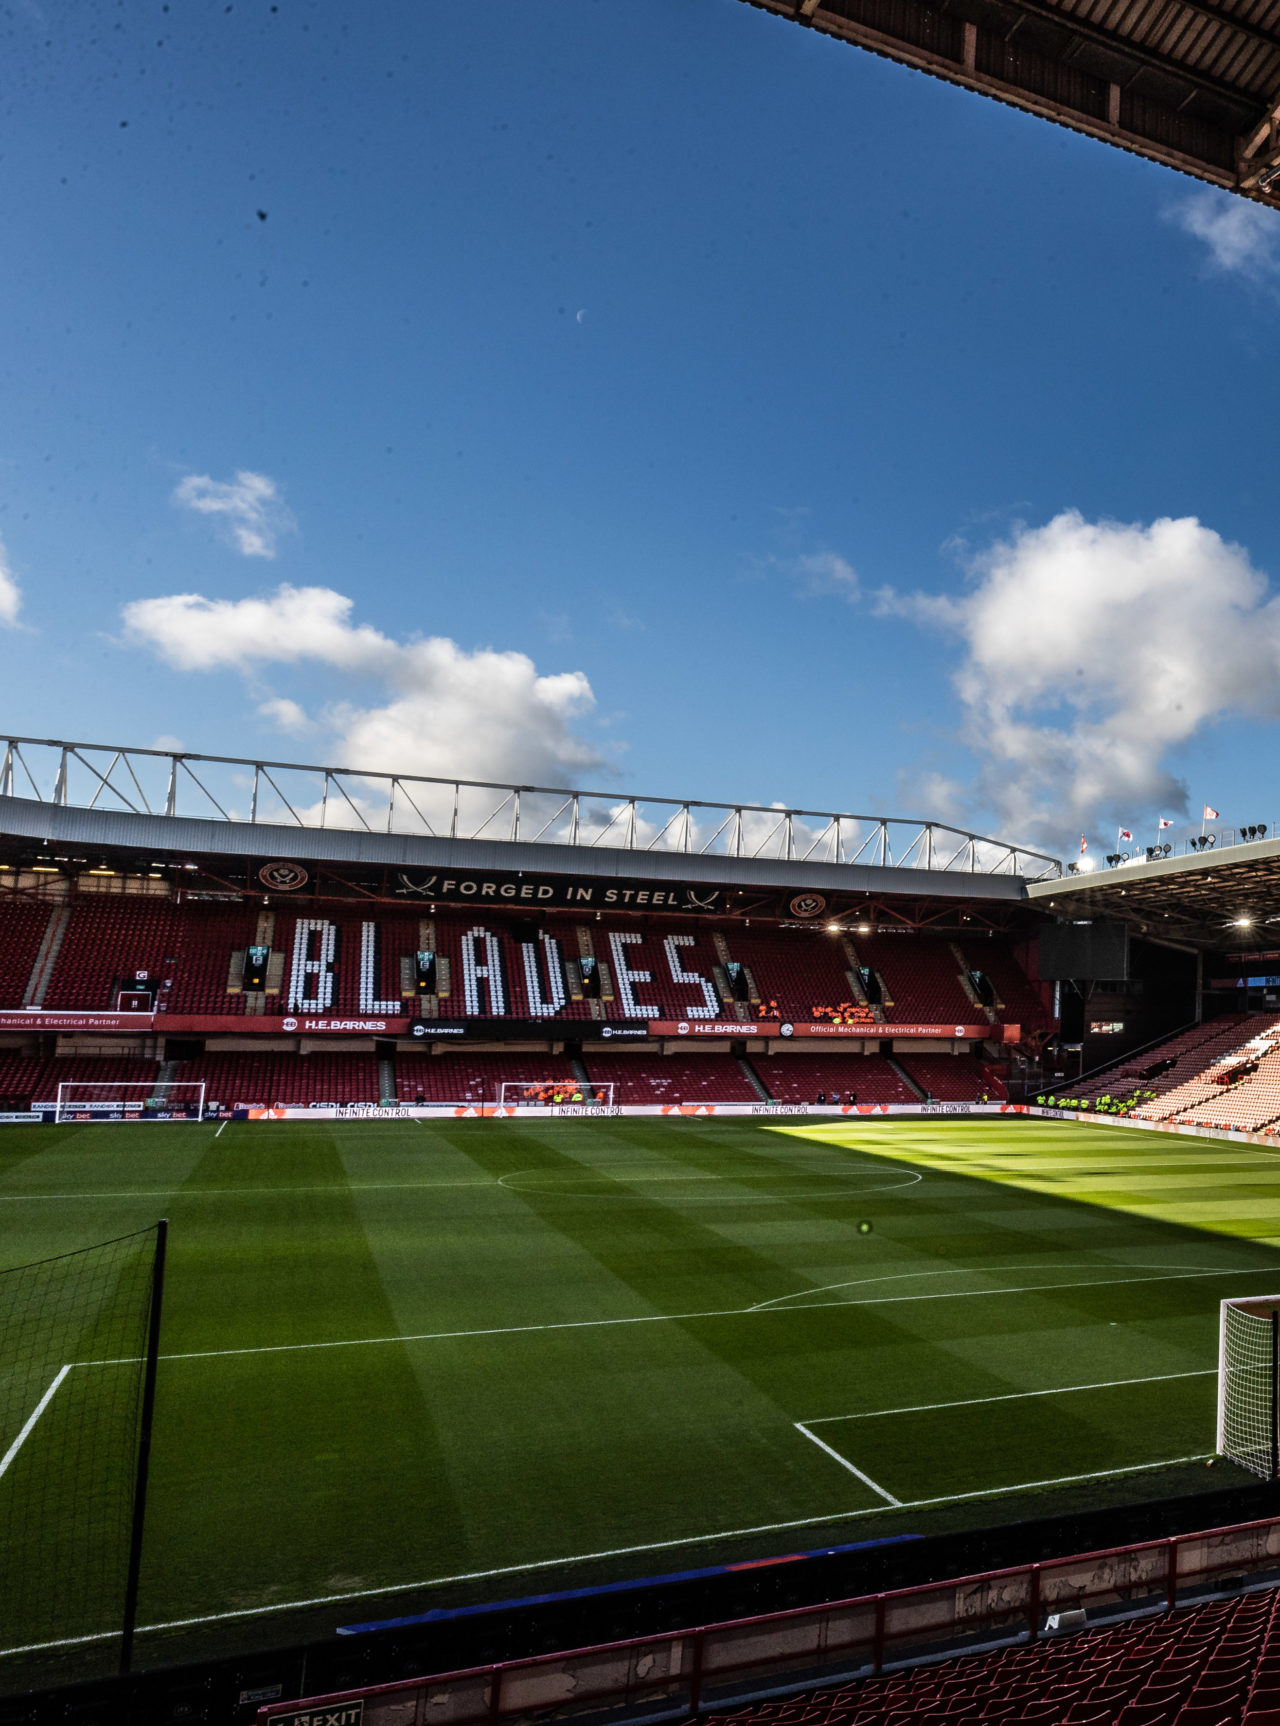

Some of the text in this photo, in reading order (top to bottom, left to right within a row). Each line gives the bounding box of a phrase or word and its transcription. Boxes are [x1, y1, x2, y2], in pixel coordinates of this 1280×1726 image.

[442, 881, 678, 905] FORGED IN STEEL
[287, 918, 720, 1018] BLADES
[45, 1017, 86, 1026] Electrical
[88, 1018, 120, 1026] Partner
[305, 1020, 386, 1030] H.E.BARNES
[695, 1025, 757, 1033] H.E.BARNES
[810, 1025, 836, 1033] Official
[335, 1108, 411, 1117] INFINITE CONTROL
[559, 1107, 624, 1115] INFINITE CONTROL
[752, 1106, 809, 1114] INFINITE CONTROL
[921, 1105, 971, 1113] INFINITE CONTROL
[204, 1111, 218, 1119] sky
[312, 1708, 361, 1726] EXIT
